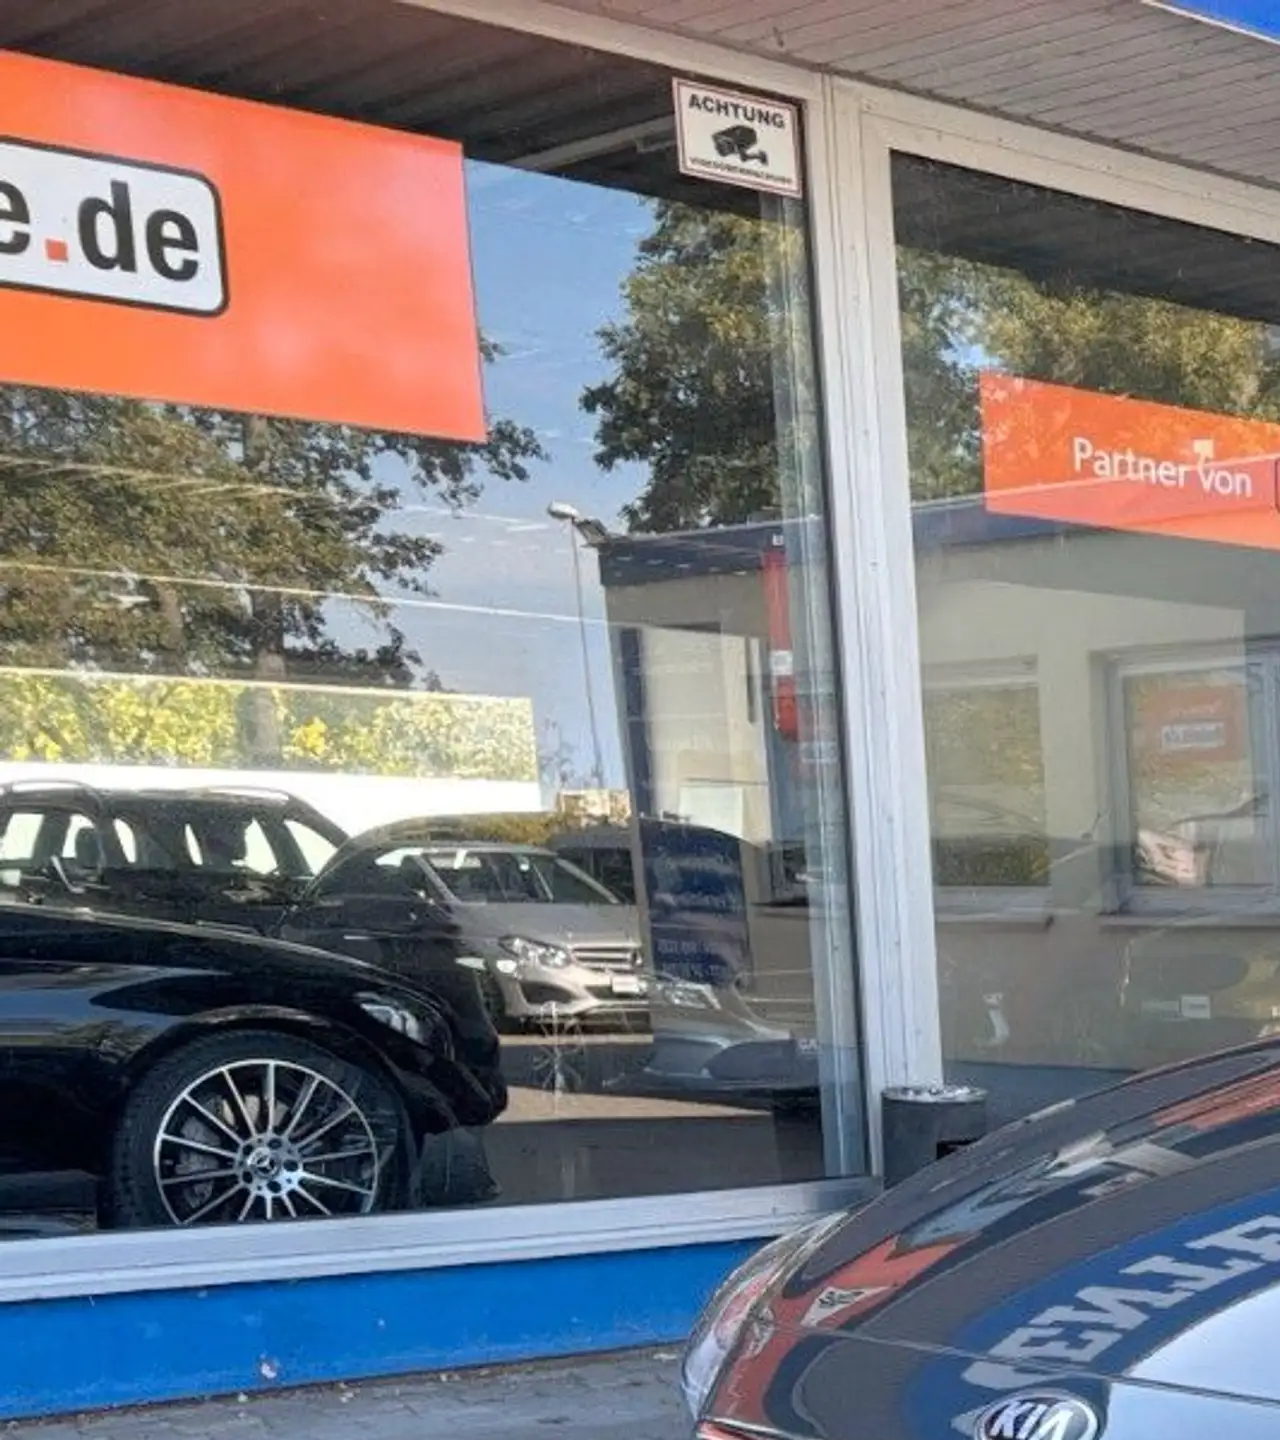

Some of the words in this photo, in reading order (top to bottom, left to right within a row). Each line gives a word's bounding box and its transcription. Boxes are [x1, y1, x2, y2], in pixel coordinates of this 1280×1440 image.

[688, 93, 786, 129] ACHTUNG
[1073, 436, 1187, 488] Partner
[1200, 465, 1253, 498] von
